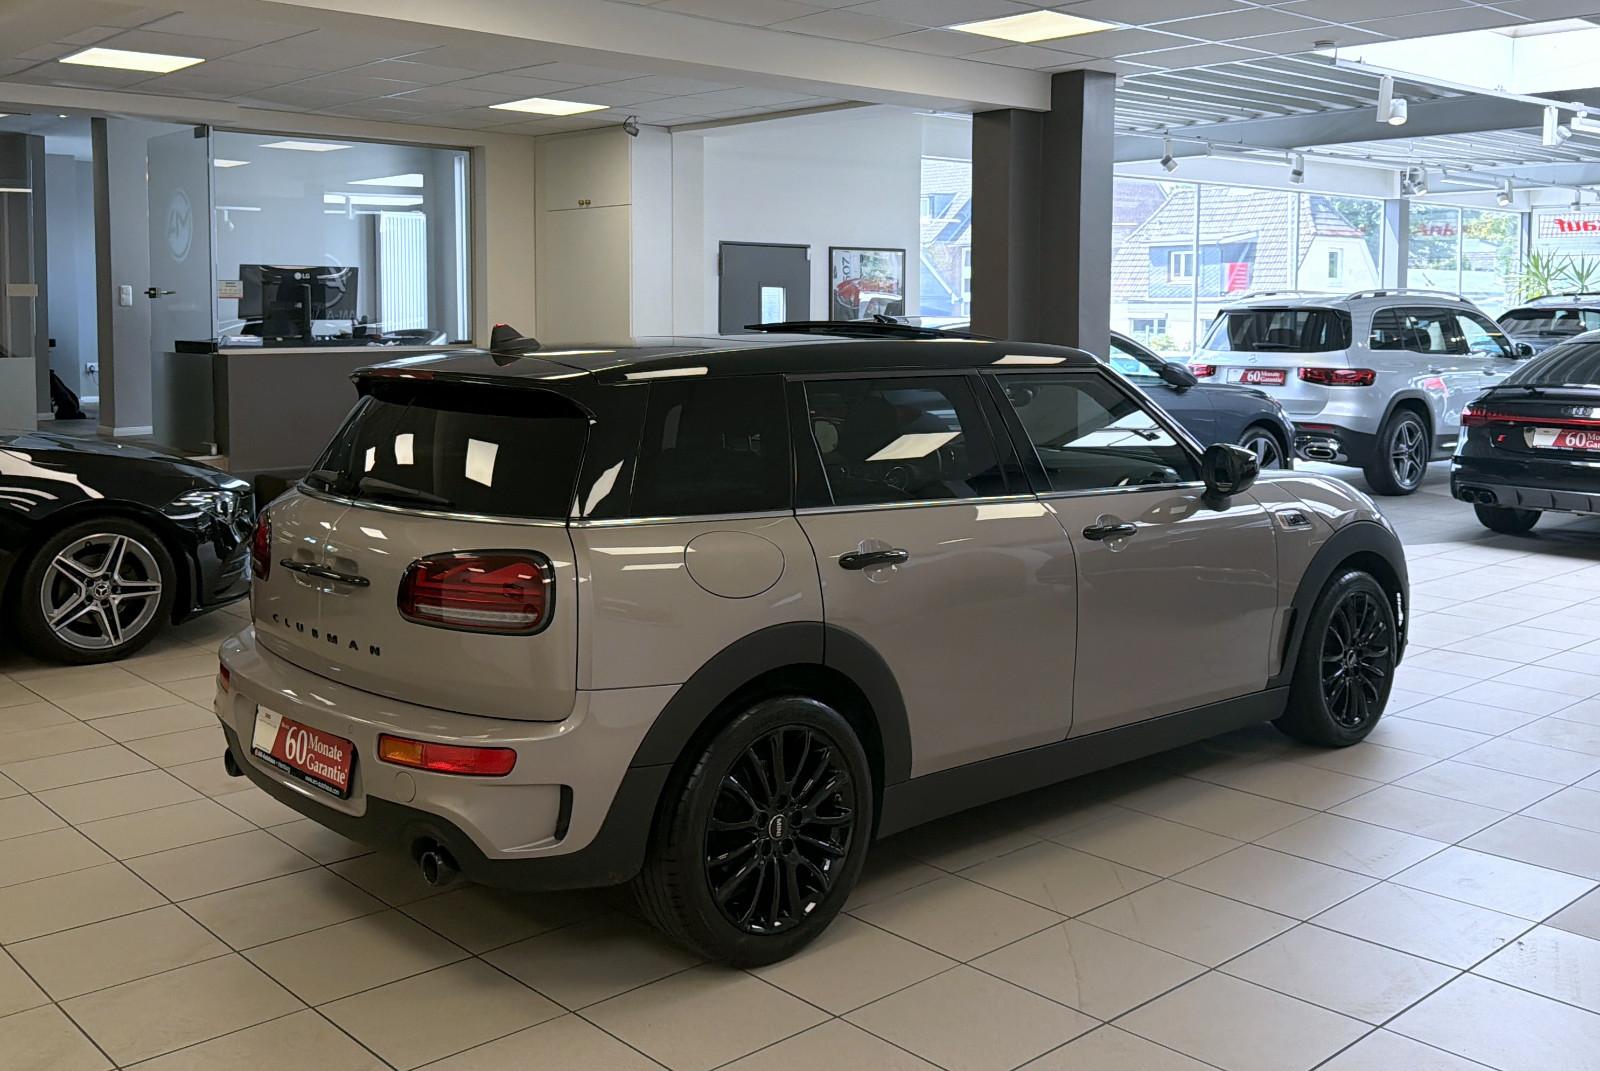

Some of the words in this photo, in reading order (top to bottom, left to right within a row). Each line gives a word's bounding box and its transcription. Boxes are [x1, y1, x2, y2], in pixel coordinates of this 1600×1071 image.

[1247, 371, 1260, 381] 60
[1566, 431, 1586, 447] 60
[272, 613, 381, 656] CLUBMAN
[285, 726, 308, 765] 60
[308, 733, 343, 762] Monate
